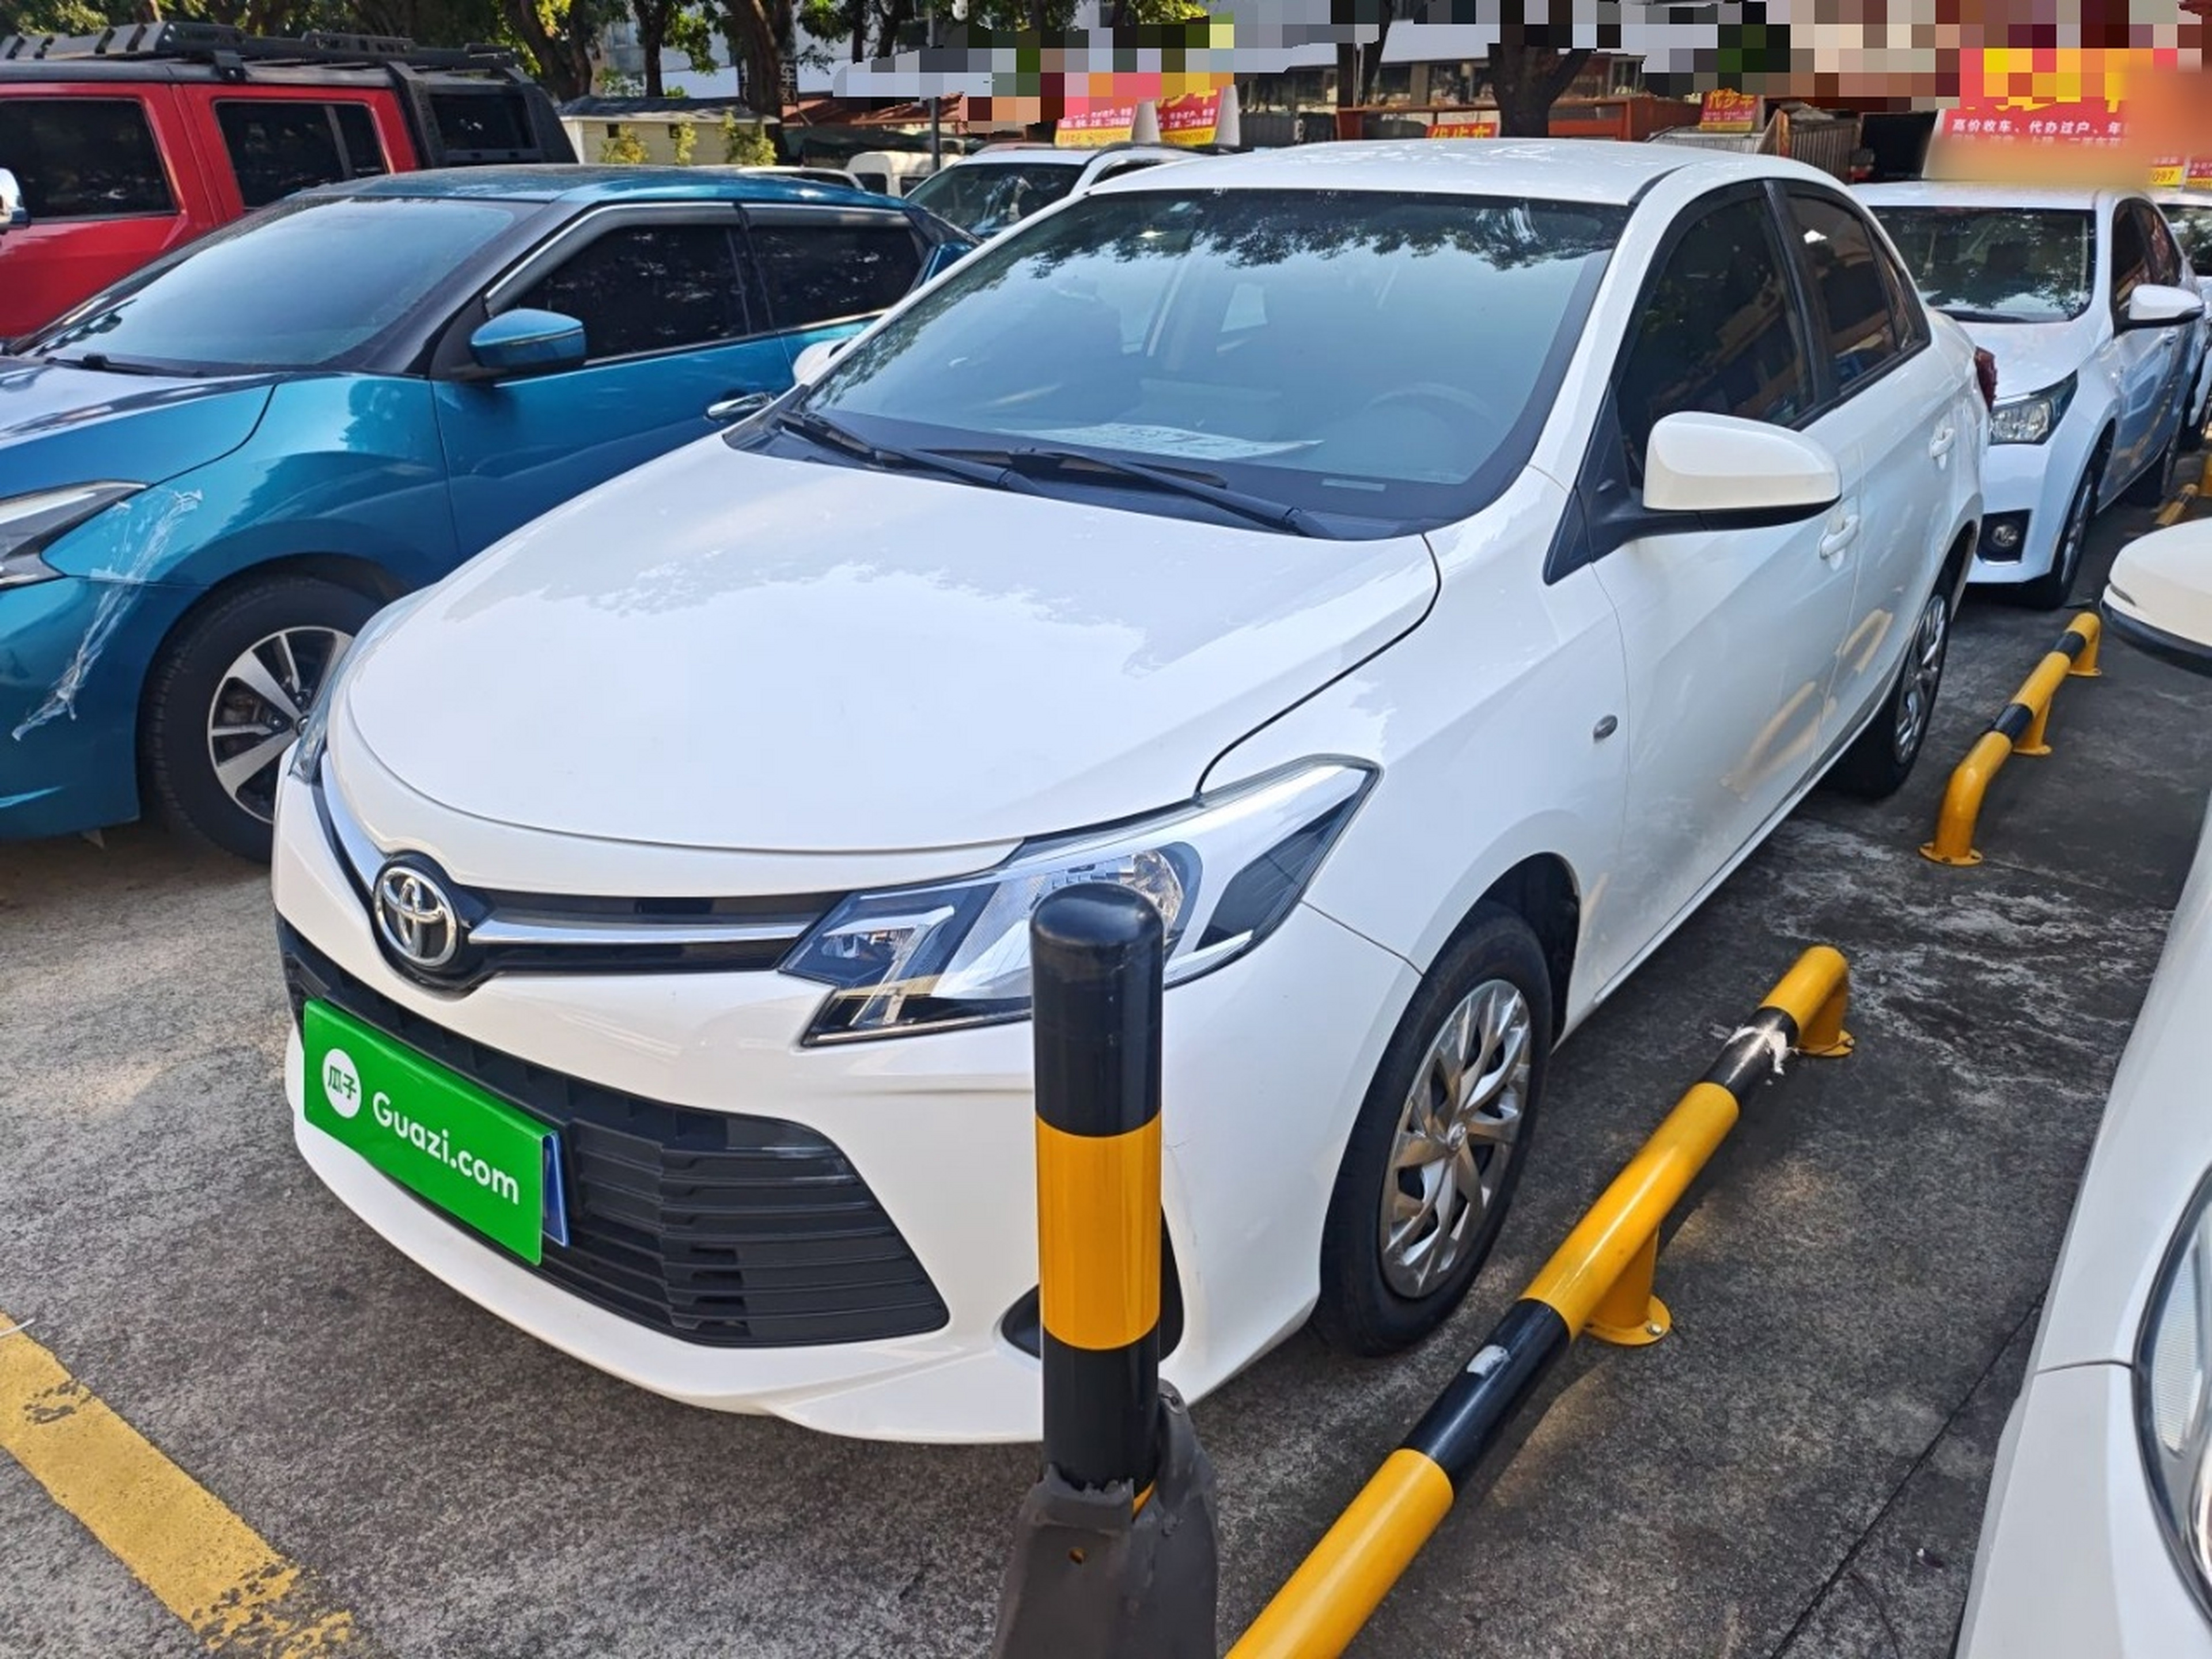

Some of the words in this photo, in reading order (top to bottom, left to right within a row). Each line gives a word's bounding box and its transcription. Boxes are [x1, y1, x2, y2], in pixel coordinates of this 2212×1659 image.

[1952, 119, 2130, 135] 高价收车、代办过户、年
[328, 1064, 357, 1100] 瓜子
[373, 1091, 520, 1206] Guazi.com
